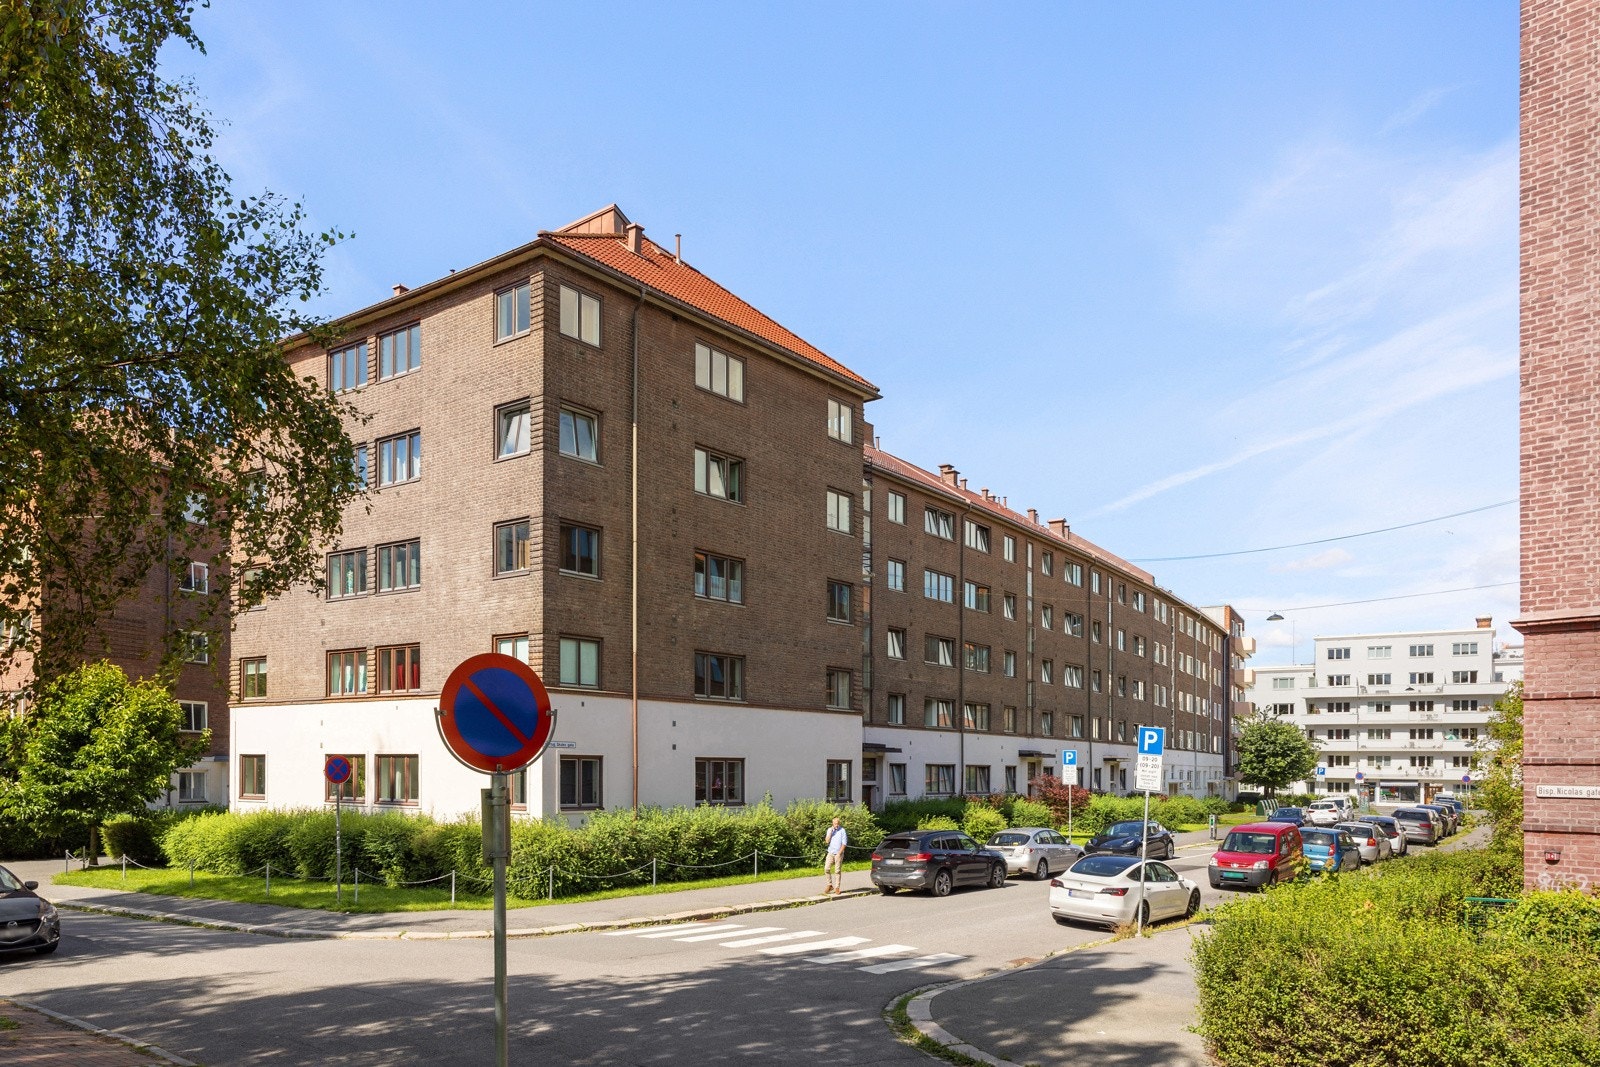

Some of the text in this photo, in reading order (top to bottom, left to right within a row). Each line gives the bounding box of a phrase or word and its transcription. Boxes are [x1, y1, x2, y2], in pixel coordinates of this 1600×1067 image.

[1144, 731, 1158, 751] P
[1066, 752, 1074, 764] P
[1557, 787, 1583, 796] Nicolas
